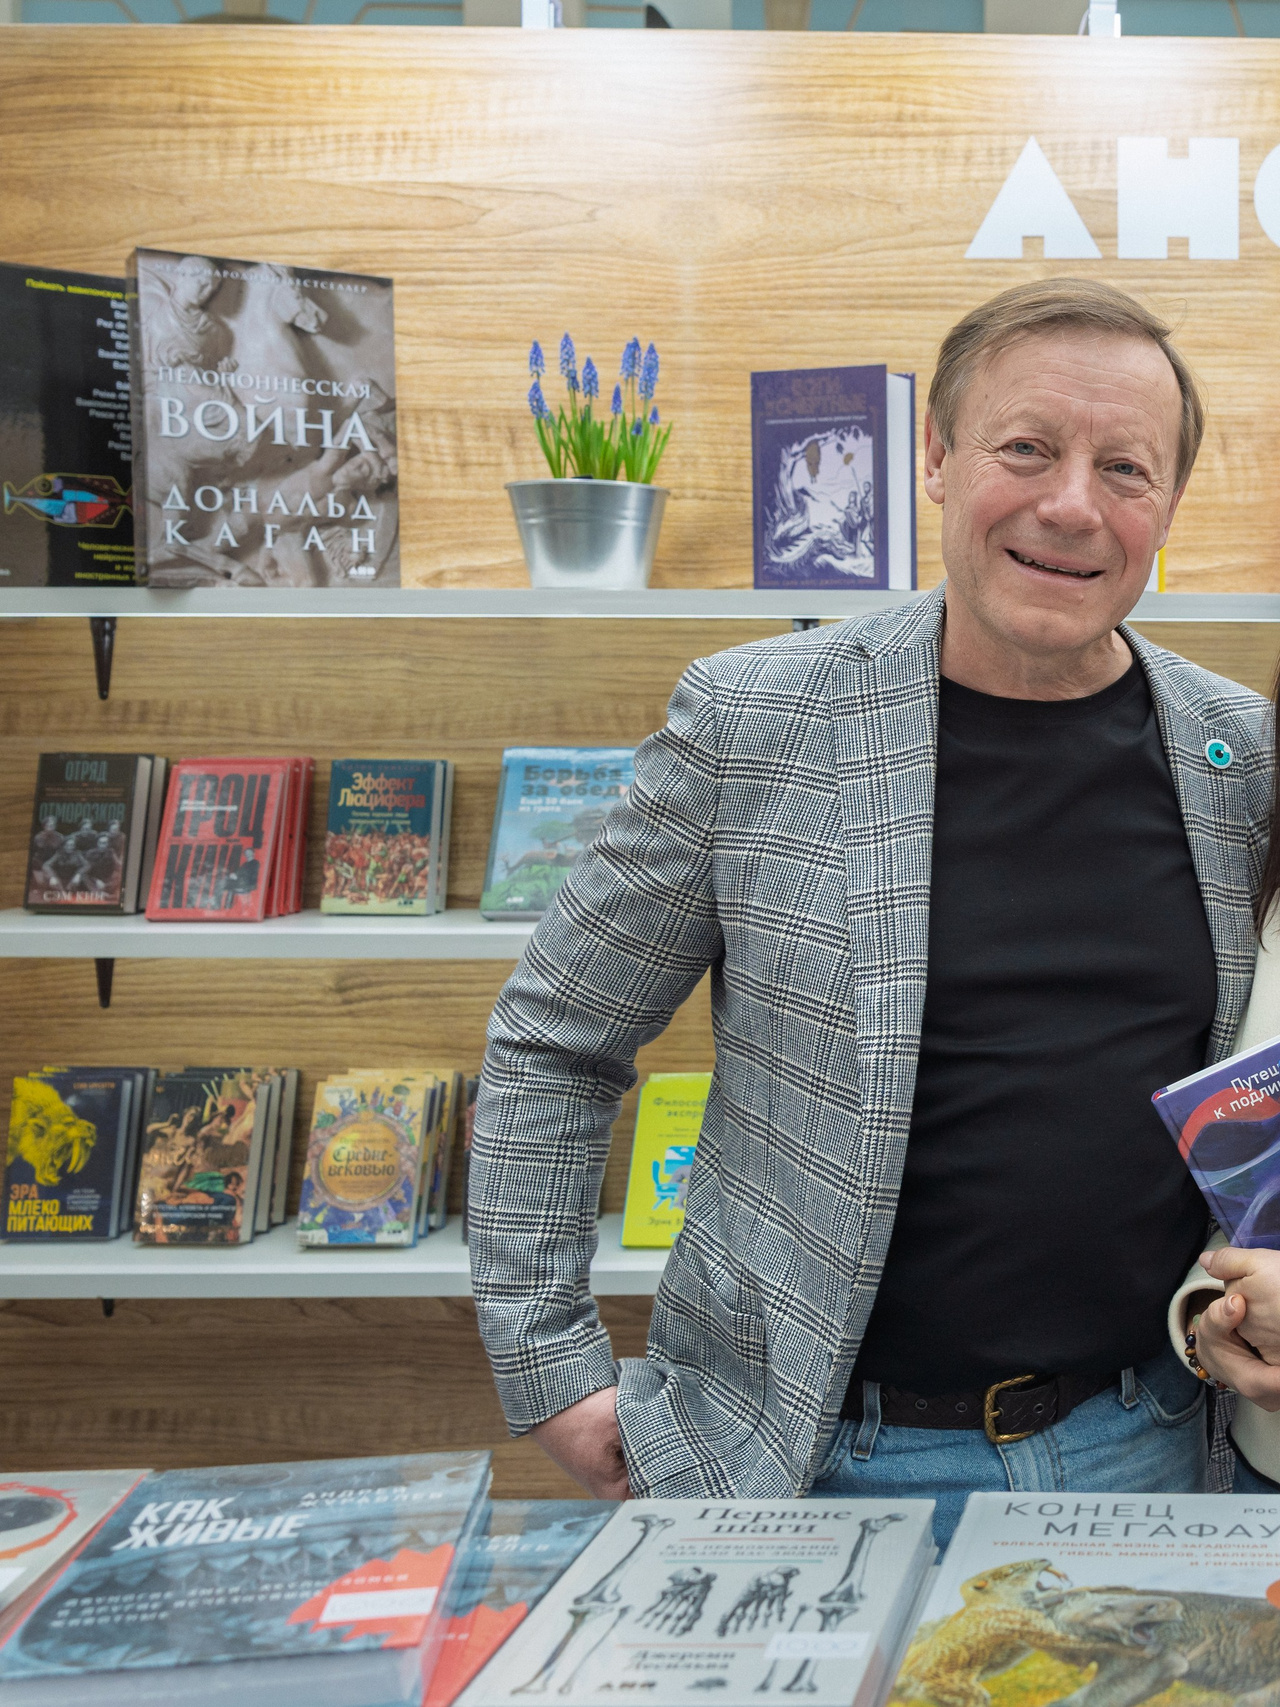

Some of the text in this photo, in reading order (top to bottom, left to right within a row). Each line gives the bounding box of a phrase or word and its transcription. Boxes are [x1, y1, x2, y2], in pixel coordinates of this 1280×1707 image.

[157, 366, 372, 399] ПЕЛОПОННЕССКАЯ
[158, 395, 378, 452] ВОЙНА
[162, 485, 378, 521] ДОНАЛЬД
[164, 519, 377, 553] КАГАН
[64, 760, 108, 783] ОТРЯД
[524, 764, 622, 784] Борьба
[351, 772, 416, 795] Эффект
[522, 781, 621, 799] за обед
[337, 787, 426, 812] Люцифера
[39, 802, 126, 823] ОТМОРОЗКОВ
[172, 773, 271, 849] ТРОЦ
[43, 890, 72, 901] СЭМ
[1213, 1106, 1226, 1120] к
[331, 1146, 393, 1164] Средне-
[327, 1163, 396, 1177] вековью
[10, 1183, 39, 1199] ЭРА
[8, 1199, 60, 1216] МЛЕКО
[6, 1214, 94, 1233] ПИТАЮЩИХ
[133, 1496, 236, 1526] КАК
[694, 1506, 853, 1523] Первые
[1004, 1502, 1175, 1520] КОНЕЦ
[110, 1513, 310, 1552] ЖИВЫЕ
[712, 1523, 819, 1534] шаги
[632, 1650, 736, 1661] Джереми
